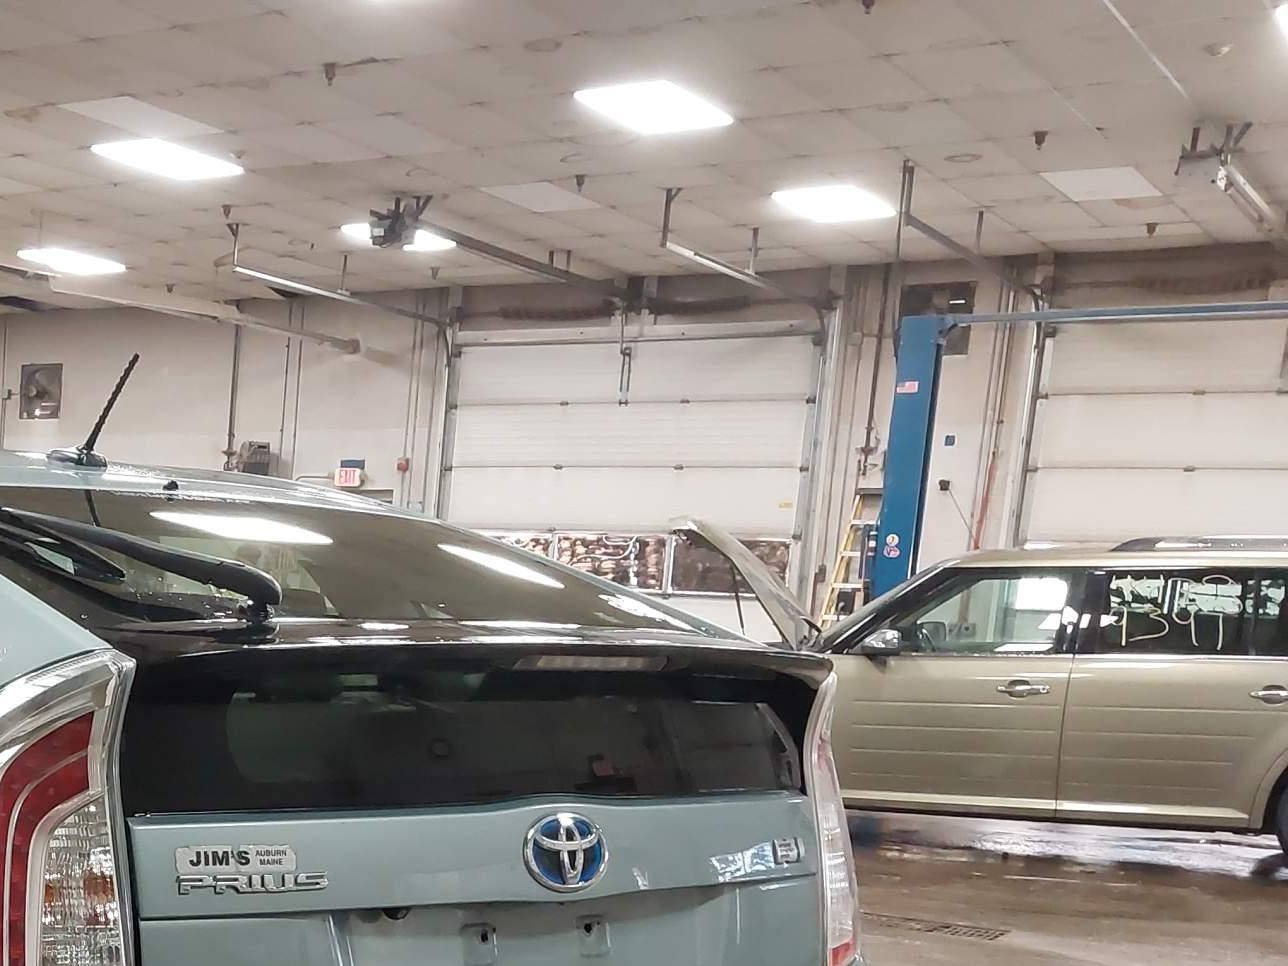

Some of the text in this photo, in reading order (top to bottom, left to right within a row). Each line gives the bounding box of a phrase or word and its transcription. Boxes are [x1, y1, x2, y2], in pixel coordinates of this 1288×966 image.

[339, 469, 357, 484] EXIT
[188, 849, 251, 867] JIM'S
[255, 849, 287, 858] AUBURN
[259, 858, 284, 866] MAINE
[176, 871, 329, 896] PRIUS
